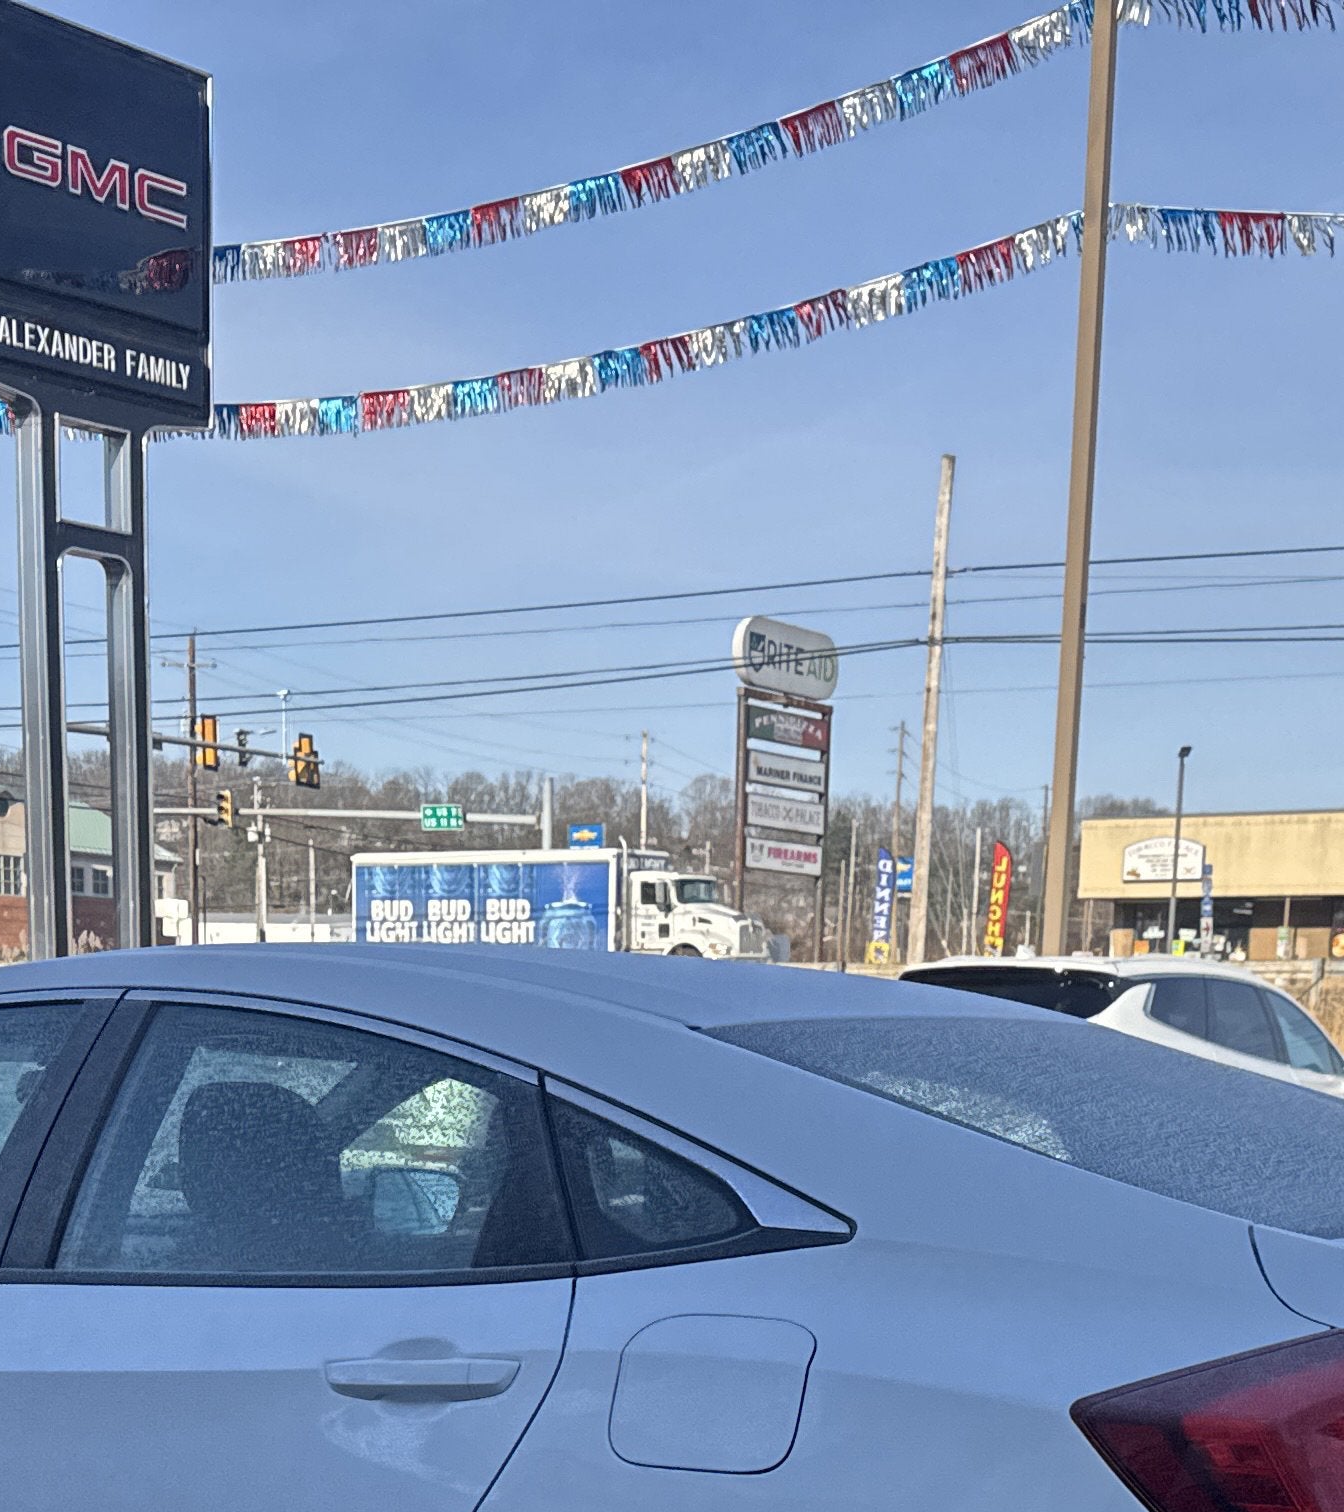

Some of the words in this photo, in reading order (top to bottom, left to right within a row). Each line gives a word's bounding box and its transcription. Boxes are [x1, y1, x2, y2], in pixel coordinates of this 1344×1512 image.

[3, 125, 187, 231] GMC
[124, 348, 191, 391] FAMILY
[767, 639, 805, 677] RITE
[806, 651, 834, 683] AID
[767, 846, 818, 865] FIREARMS
[370, 900, 414, 921] BUD
[428, 899, 472, 921] BUD
[485, 898, 531, 920] BUD
[365, 920, 418, 943] LIGHT
[422, 920, 475, 944] LIGHT
[480, 920, 536, 944] LIGHT
